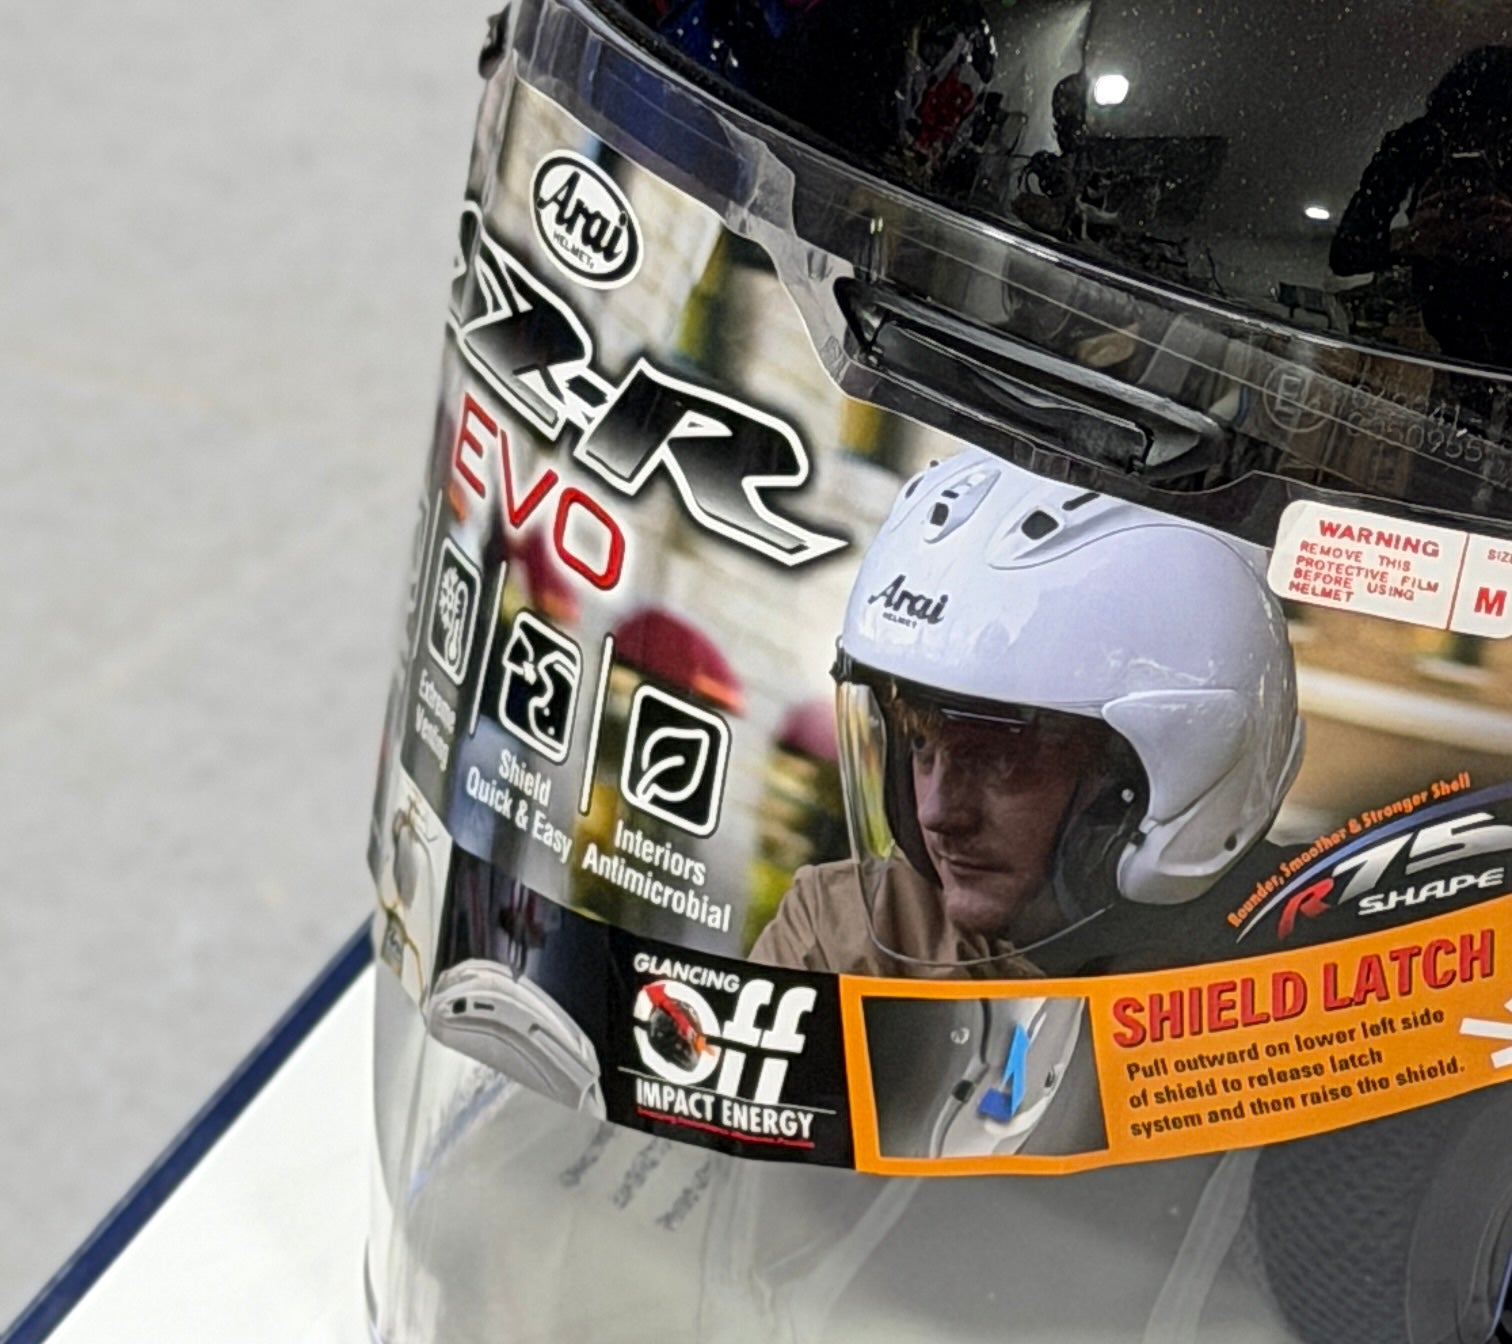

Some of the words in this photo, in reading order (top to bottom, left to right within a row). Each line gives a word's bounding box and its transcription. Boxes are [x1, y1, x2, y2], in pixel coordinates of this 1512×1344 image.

[537, 171, 628, 263] Arai
[553, 231, 593, 267] HELMET
[452, 392, 626, 592] EVO
[1300, 540, 1364, 563] REMOVE
[1379, 554, 1411, 572] THIS
[1319, 519, 1440, 557] WARNING
[868, 574, 948, 624] Arai
[1289, 581, 1355, 603] HELMET
[1293, 568, 1353, 589] BEFORE
[1367, 582, 1415, 602] USING
[1296, 555, 1388, 583] PROTECTIVE
[1401, 575, 1439, 593] FILM
[1474, 587, 1507, 617] M
[498, 748, 552, 806] Shield
[466, 766, 513, 819] Quick
[514, 803, 528, 831] &
[532, 818, 573, 865] Easy
[614, 820, 707, 886] Interiors
[1227, 874, 1284, 928] Rounder,
[1279, 828, 1347, 879] Smoother
[1348, 818, 1362, 835] &
[1361, 790, 1428, 829] Stronger
[1431, 771, 1471, 799] Shell
[582, 843, 732, 933] Antimicrobial
[1358, 867, 1505, 916] SHAPE
[633, 953, 740, 993] GLANCING
[1113, 972, 1308, 1048] SHIELD
[1323, 929, 1495, 1012] LATCH
[632, 979, 818, 1105] Off
[1127, 1058, 1168, 1081] Pull
[1174, 1043, 1259, 1073] outward
[1265, 1042, 1290, 1057] on
[1295, 1027, 1356, 1052] lower
[1361, 1017, 1396, 1039] left
[1401, 1008, 1444, 1031] side
[636, 1078, 715, 1121] IMPACT
[721, 1099, 814, 1138] ENERGY
[1129, 1088, 1148, 1108] of
[1154, 1078, 1217, 1104] shield
[1222, 1077, 1242, 1093] to
[1248, 1062, 1325, 1089] release
[1329, 1048, 1383, 1073] latch
[1131, 1113, 1202, 1139] system
[1208, 1101, 1245, 1124] and
[1250, 1096, 1296, 1116] then
[1300, 1085, 1353, 1107] raise
[1357, 1076, 1390, 1095] the
[1395, 1056, 1466, 1086] shield.
